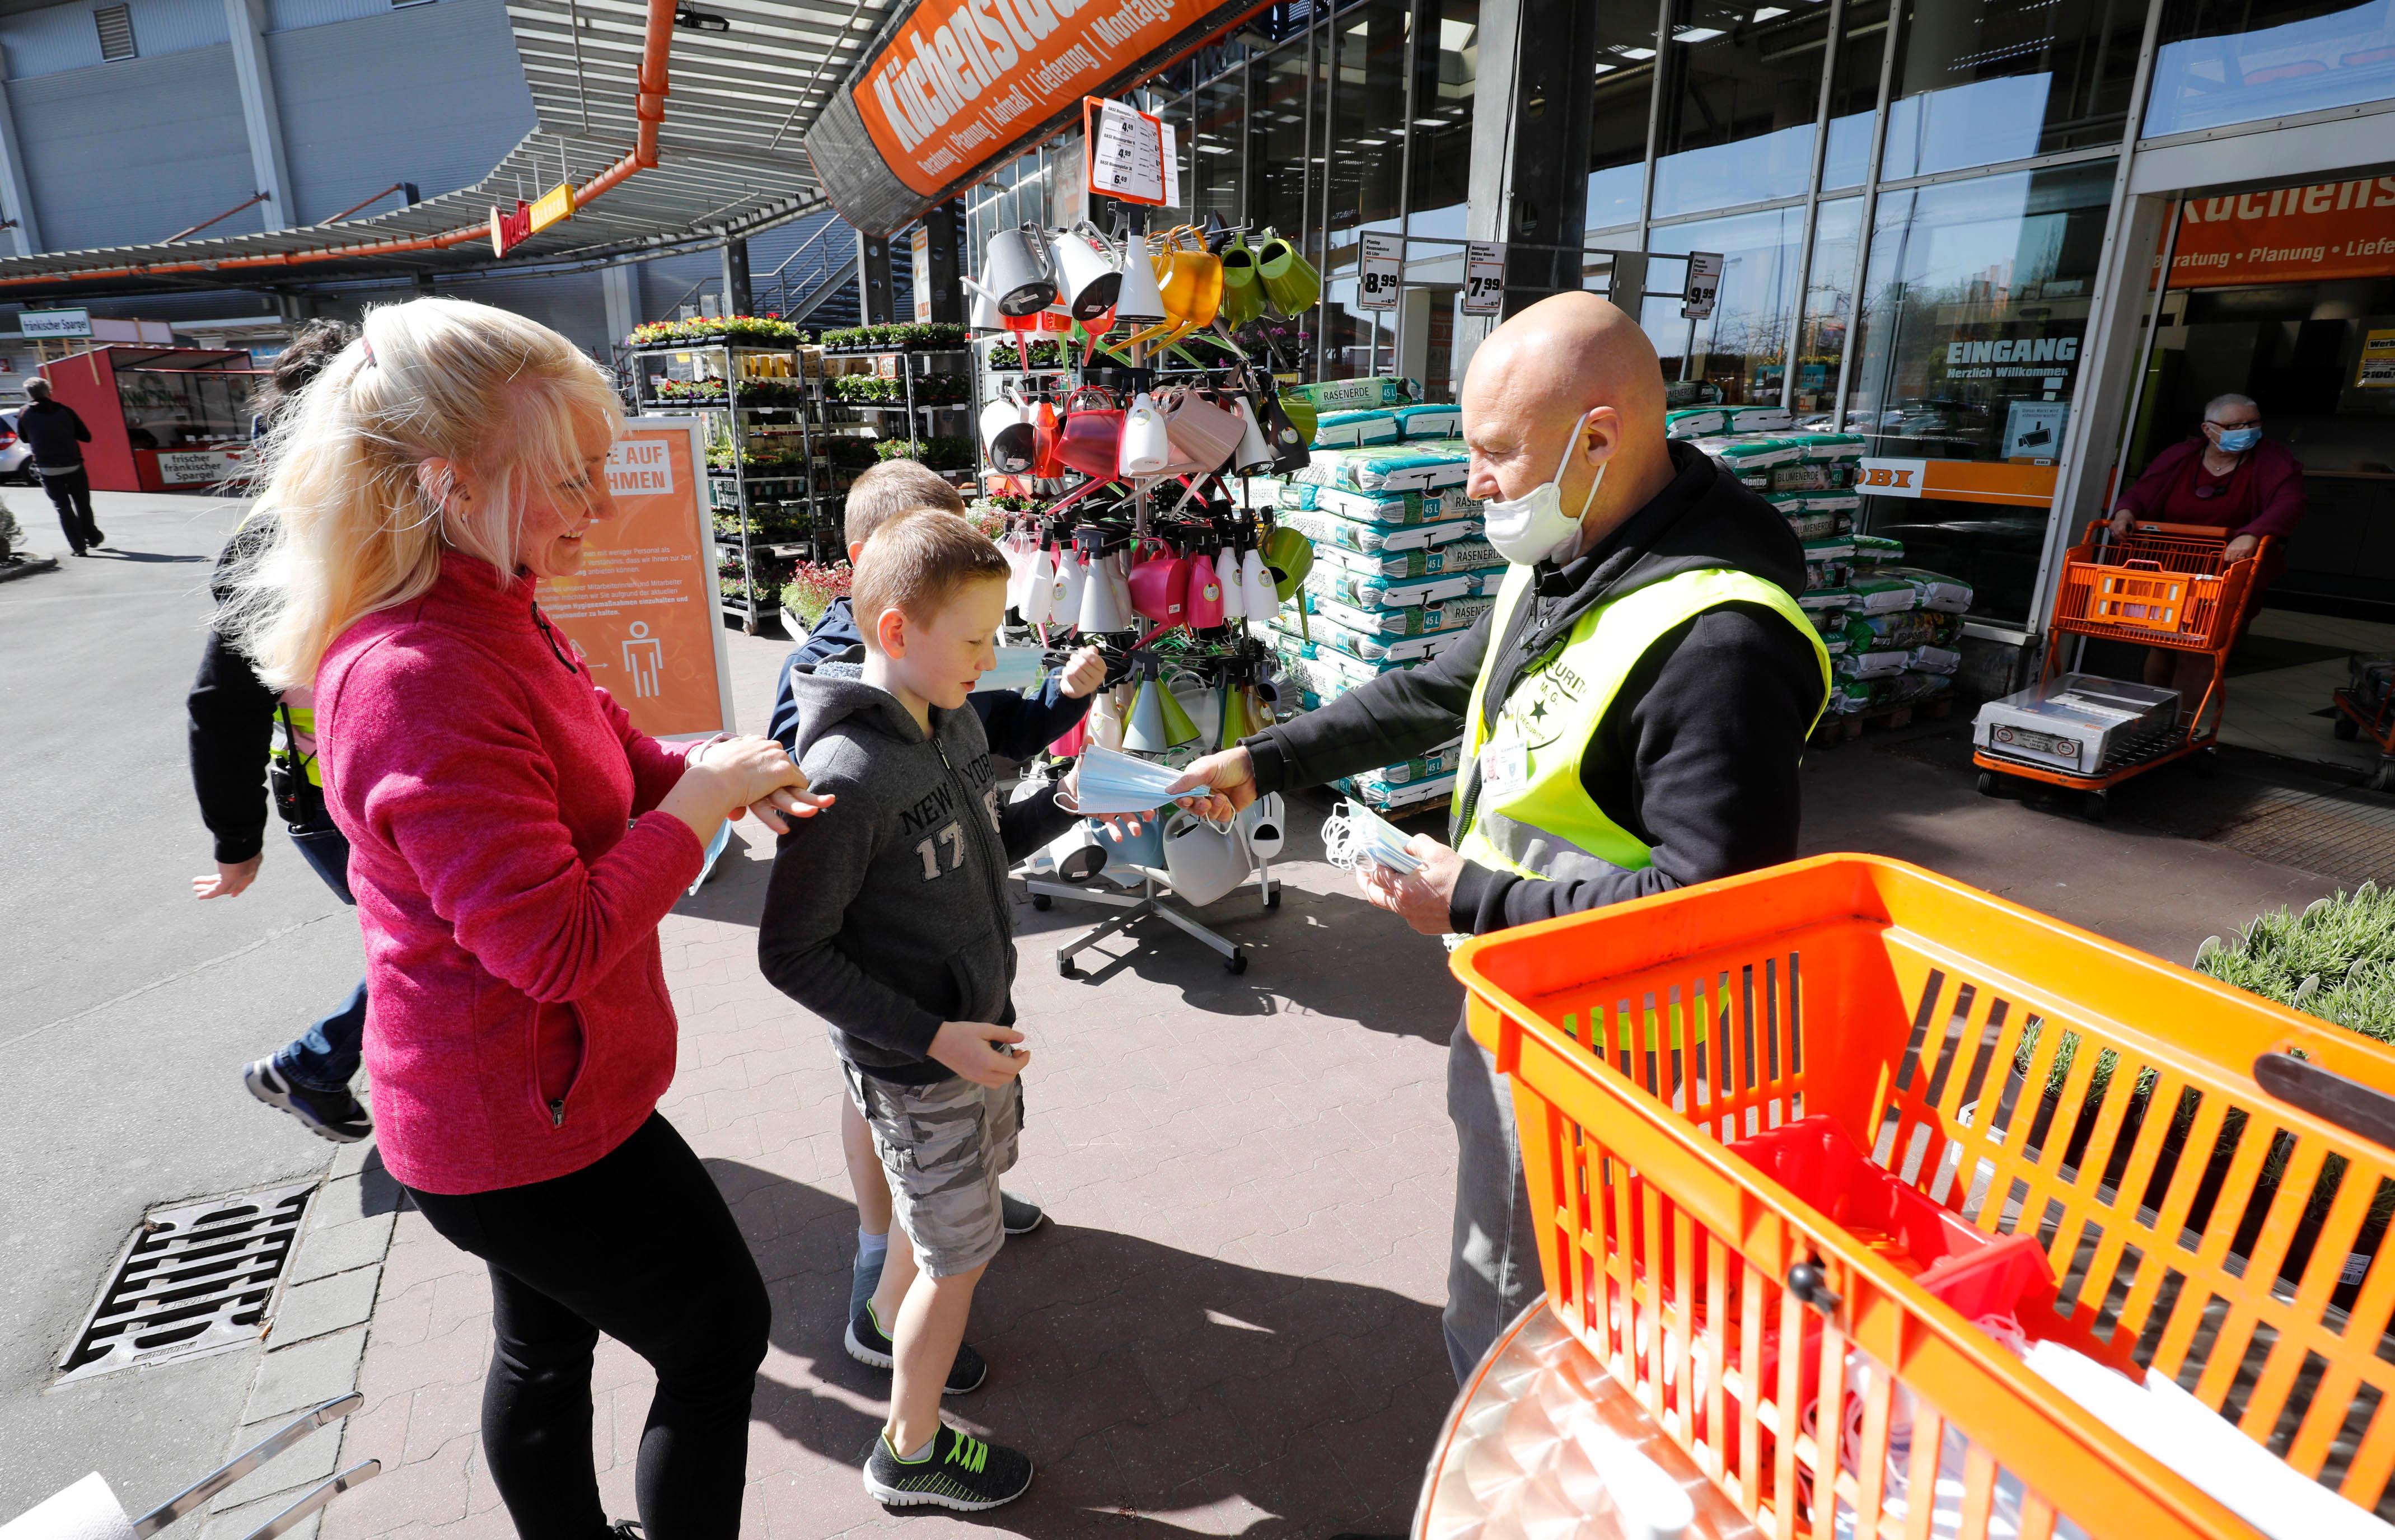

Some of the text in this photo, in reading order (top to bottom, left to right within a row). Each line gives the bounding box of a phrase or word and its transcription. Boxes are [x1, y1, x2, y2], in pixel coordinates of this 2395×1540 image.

[949, 120, 997, 152] Planung
[985, 83, 1033, 127] Aufmaß
[1026, 43, 1101, 96] Lieferung
[2248, 245, 2326, 263] Planung
[1365, 272, 1398, 294] 8,99
[1470, 276, 1500, 297] 7,99
[1690, 287, 1714, 305] 9,99
[918, 301, 930, 319] OBI
[24, 317, 87, 332] fränkischer Spargel
[1947, 338, 2078, 364] EINGANG
[1947, 367, 2069, 378] Herzlich Willkommen
[1323, 387, 1370, 401] RASENERDE
[171, 453, 211, 463] frischer
[626, 446, 662, 465] AUF
[164, 462, 221, 472] fränkischer
[176, 470, 215, 481] Spargel
[1777, 471, 1819, 483] BLUMENERDE
[1249, 489, 1274, 498] ASENERDE
[1425, 504, 1433, 513] 45
[1293, 517, 1326, 532] RASENERDE
[609, 548, 632, 557] weniger
[1428, 559, 1436, 569] 45
[651, 578, 683, 587] Mitarbeiter
[611, 590, 638, 599] aufgrund
[651, 588, 678, 596] aktuellen
[639, 596, 676, 605] einzuhalten
[598, 608, 620, 617] halten.
[1425, 616, 1434, 625] 45
[1295, 665, 1326, 687] RASENERDE
[1519, 714, 1545, 741] SECURITY
[899, 783, 954, 836] NEW
[911, 817, 964, 883] 17
